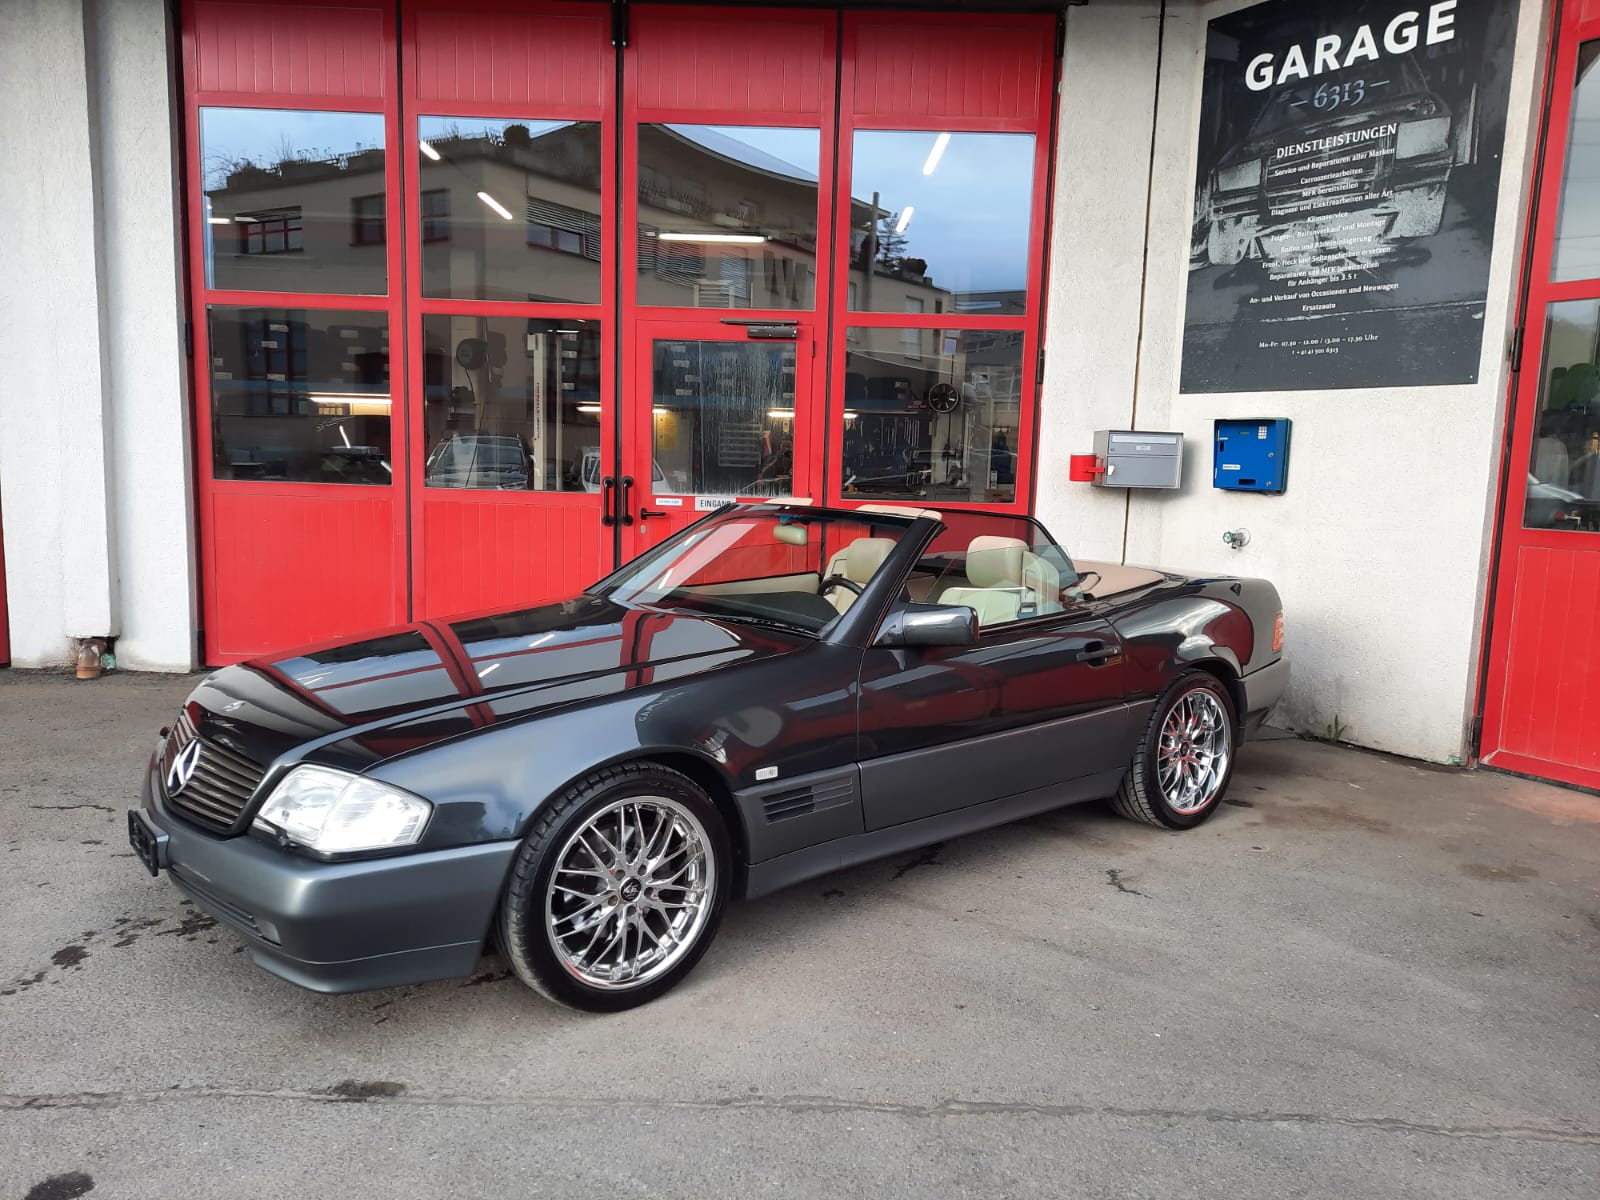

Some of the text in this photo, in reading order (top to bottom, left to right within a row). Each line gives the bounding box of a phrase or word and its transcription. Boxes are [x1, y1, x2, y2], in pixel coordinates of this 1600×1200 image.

[1245, 0, 1458, 91] GARAGE
[1313, 79, 1365, 111] 6313
[1276, 122, 1398, 159] DIENSTLEISTUNGEN
[1274, 148, 1395, 177] Service und Reparaturen aller Marken
[1300, 168, 1363, 184] Carrosseriearbeiten
[1271, 206, 1299, 217] Diagnose
[1299, 202, 1311, 211] und
[1364, 191, 1380, 201] aller
[1381, 189, 1393, 198] Art
[1307, 211, 1348, 223] Klimaservice
[1269, 270, 1307, 281] Reparaturen
[1308, 267, 1320, 276] und
[1288, 278, 1297, 287] für
[1298, 276, 1329, 287] Anhänger
[1330, 275, 1340, 283] bis
[1261, 294, 1273, 303] und
[1274, 292, 1297, 302] Verkauf
[1298, 291, 1310, 299] von
[1311, 287, 1347, 298] Occasionen
[1348, 285, 1362, 293] und
[1363, 282, 1399, 293] Neuwagen
[1302, 302, 1336, 312] Ersatzauto
